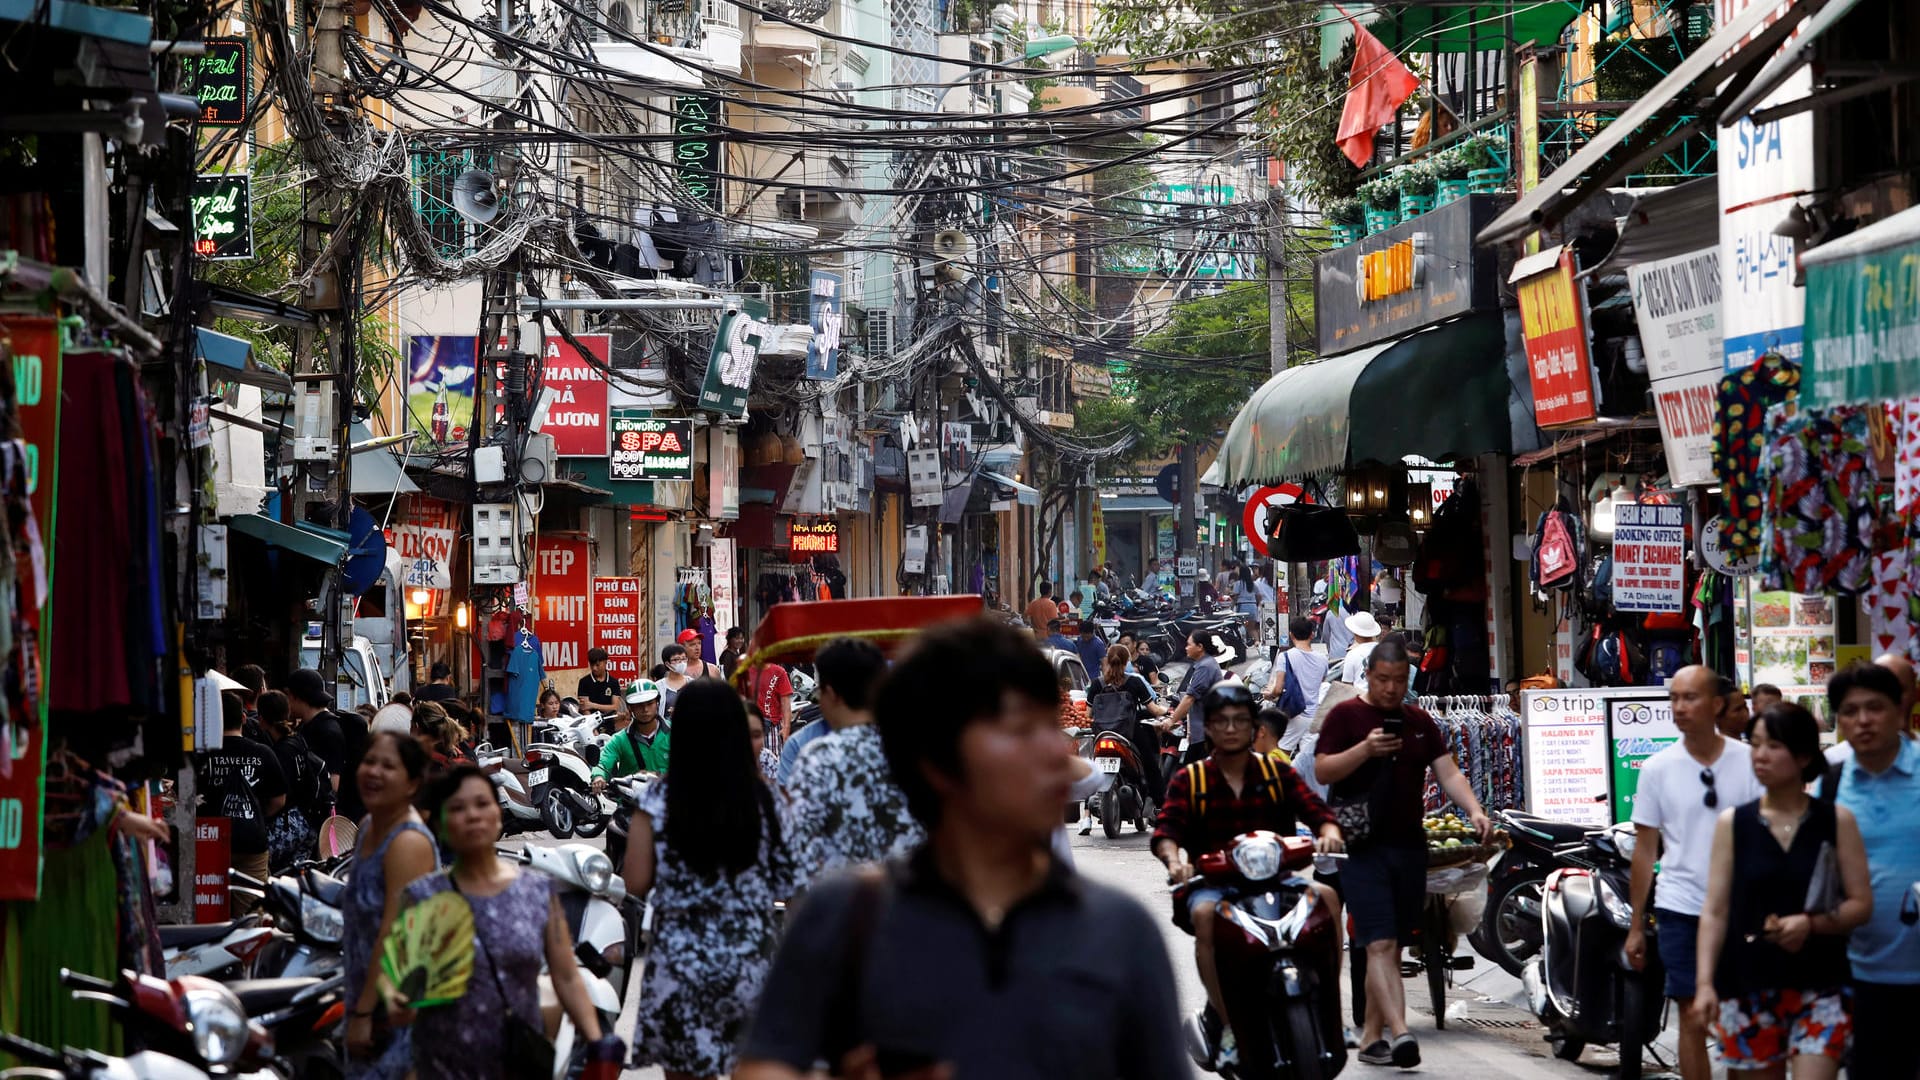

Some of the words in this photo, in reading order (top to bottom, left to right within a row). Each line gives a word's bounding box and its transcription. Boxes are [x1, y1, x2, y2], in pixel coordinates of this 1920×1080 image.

[1738, 110, 1782, 169] SPA
[199, 215, 235, 240] Spa
[1643, 267, 1676, 319] OCEAN
[1671, 261, 1695, 312] SUN
[615, 421, 667, 431] SNOWDROP
[621, 431, 682, 452] SPA
[614, 450, 645, 463] BODY
[613, 463, 645, 476] FOOT
[1615, 505, 1640, 524] OCEAN
[1640, 506, 1656, 525] SUN
[1657, 506, 1682, 526] TOURS
[1615, 529, 1652, 541] BOOKING
[1654, 530, 1681, 542] OFFICE
[540, 544, 575, 576] TÉP
[1615, 544, 1641, 563] MONEY
[1643, 545, 1681, 565] EXCHANGE
[413, 560, 439, 573] 40K
[408, 573, 435, 586] 45K
[595, 580, 619, 592] PHỞ
[622, 580, 637, 592] GÀ
[604, 596, 629, 608] BÚN
[545, 595, 586, 627] THỊT
[597, 613, 636, 624] THANG
[601, 627, 632, 639] MIẾN
[542, 641, 578, 667] MAI
[602, 645, 632, 655] ƯƠN
[620, 659, 636, 672] GÀ
[1564, 715, 1584, 723] BIG
[1578, 729, 1595, 737] BAY
[214, 756, 262, 766] TRAVELERS
